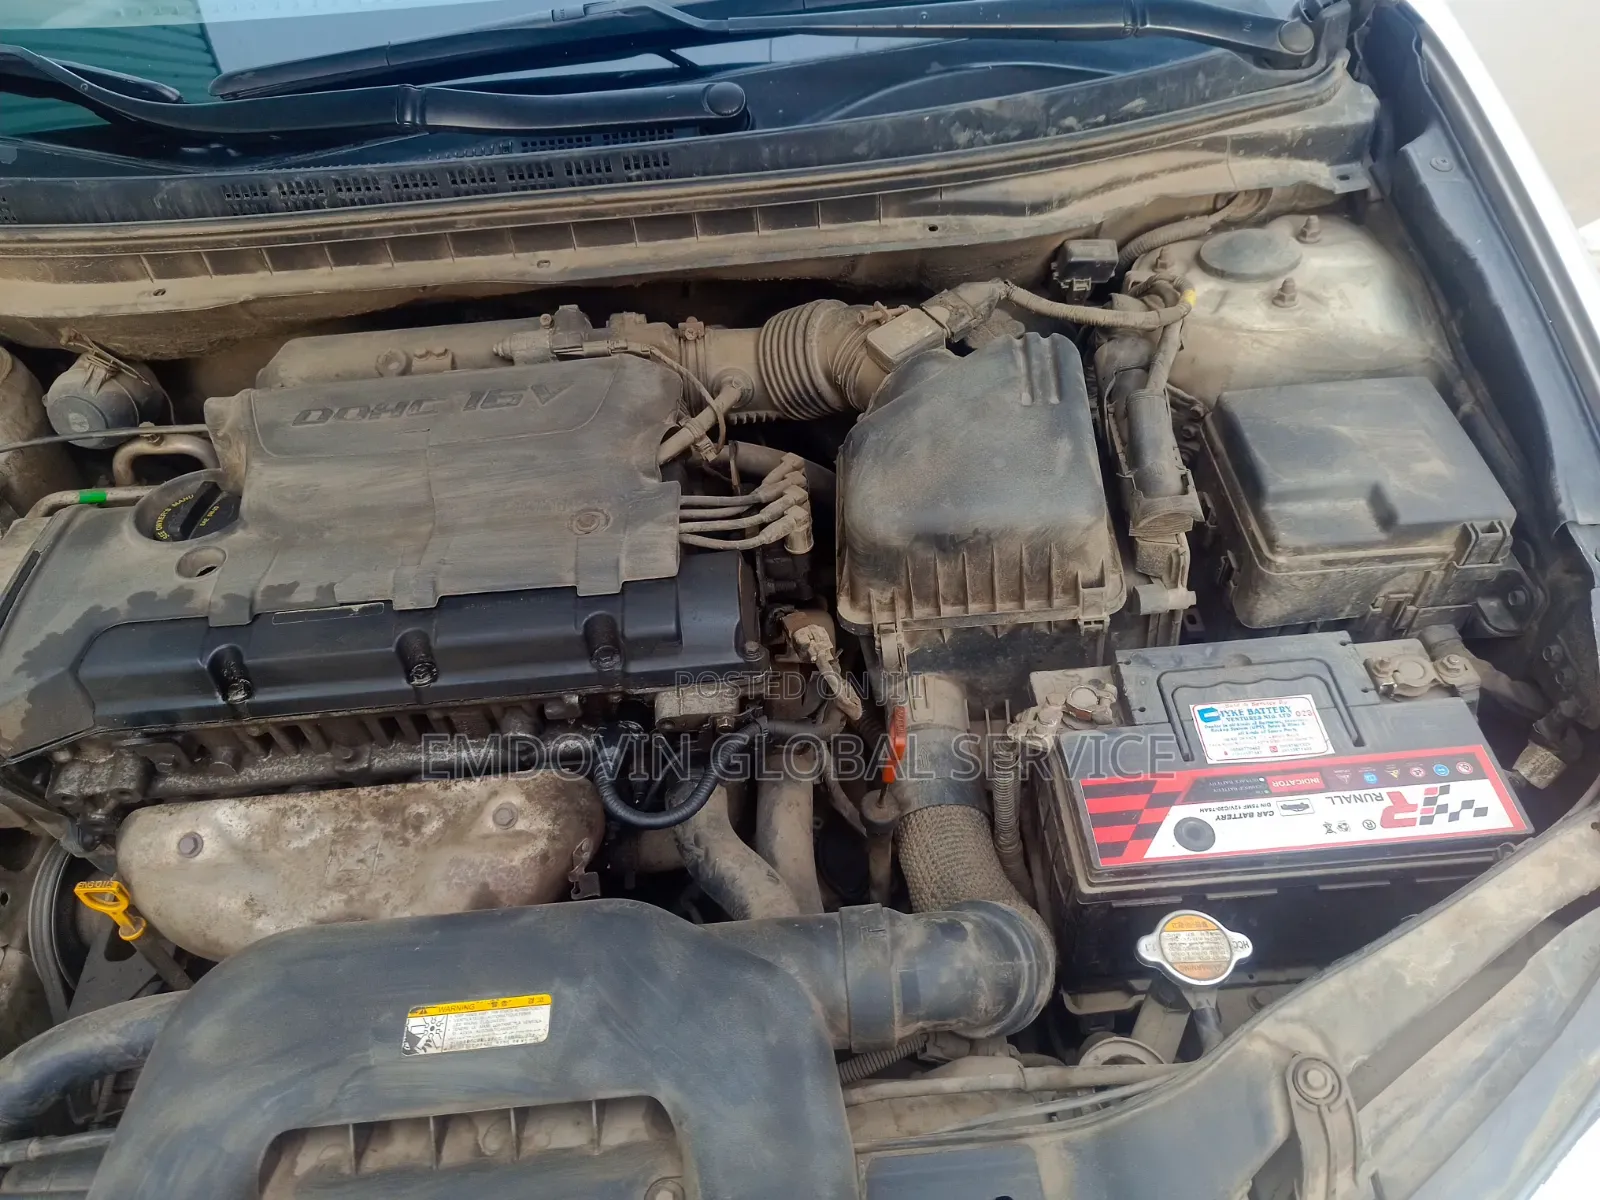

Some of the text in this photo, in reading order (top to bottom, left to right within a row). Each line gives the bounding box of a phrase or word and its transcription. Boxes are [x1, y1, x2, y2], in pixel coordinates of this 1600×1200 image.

[291, 383, 573, 427] DOHC 16V
[171, 494, 194, 507] MANU
[1247, 705, 1293, 716] BATTERY
[1272, 777, 1320, 788] INDICATOR
[1325, 792, 1385, 805] RUNALL
[1215, 810, 1275, 821] CAR BATTERY
[1232, 940, 1250, 949] HCC
[438, 1003, 475, 1013] WARNING
